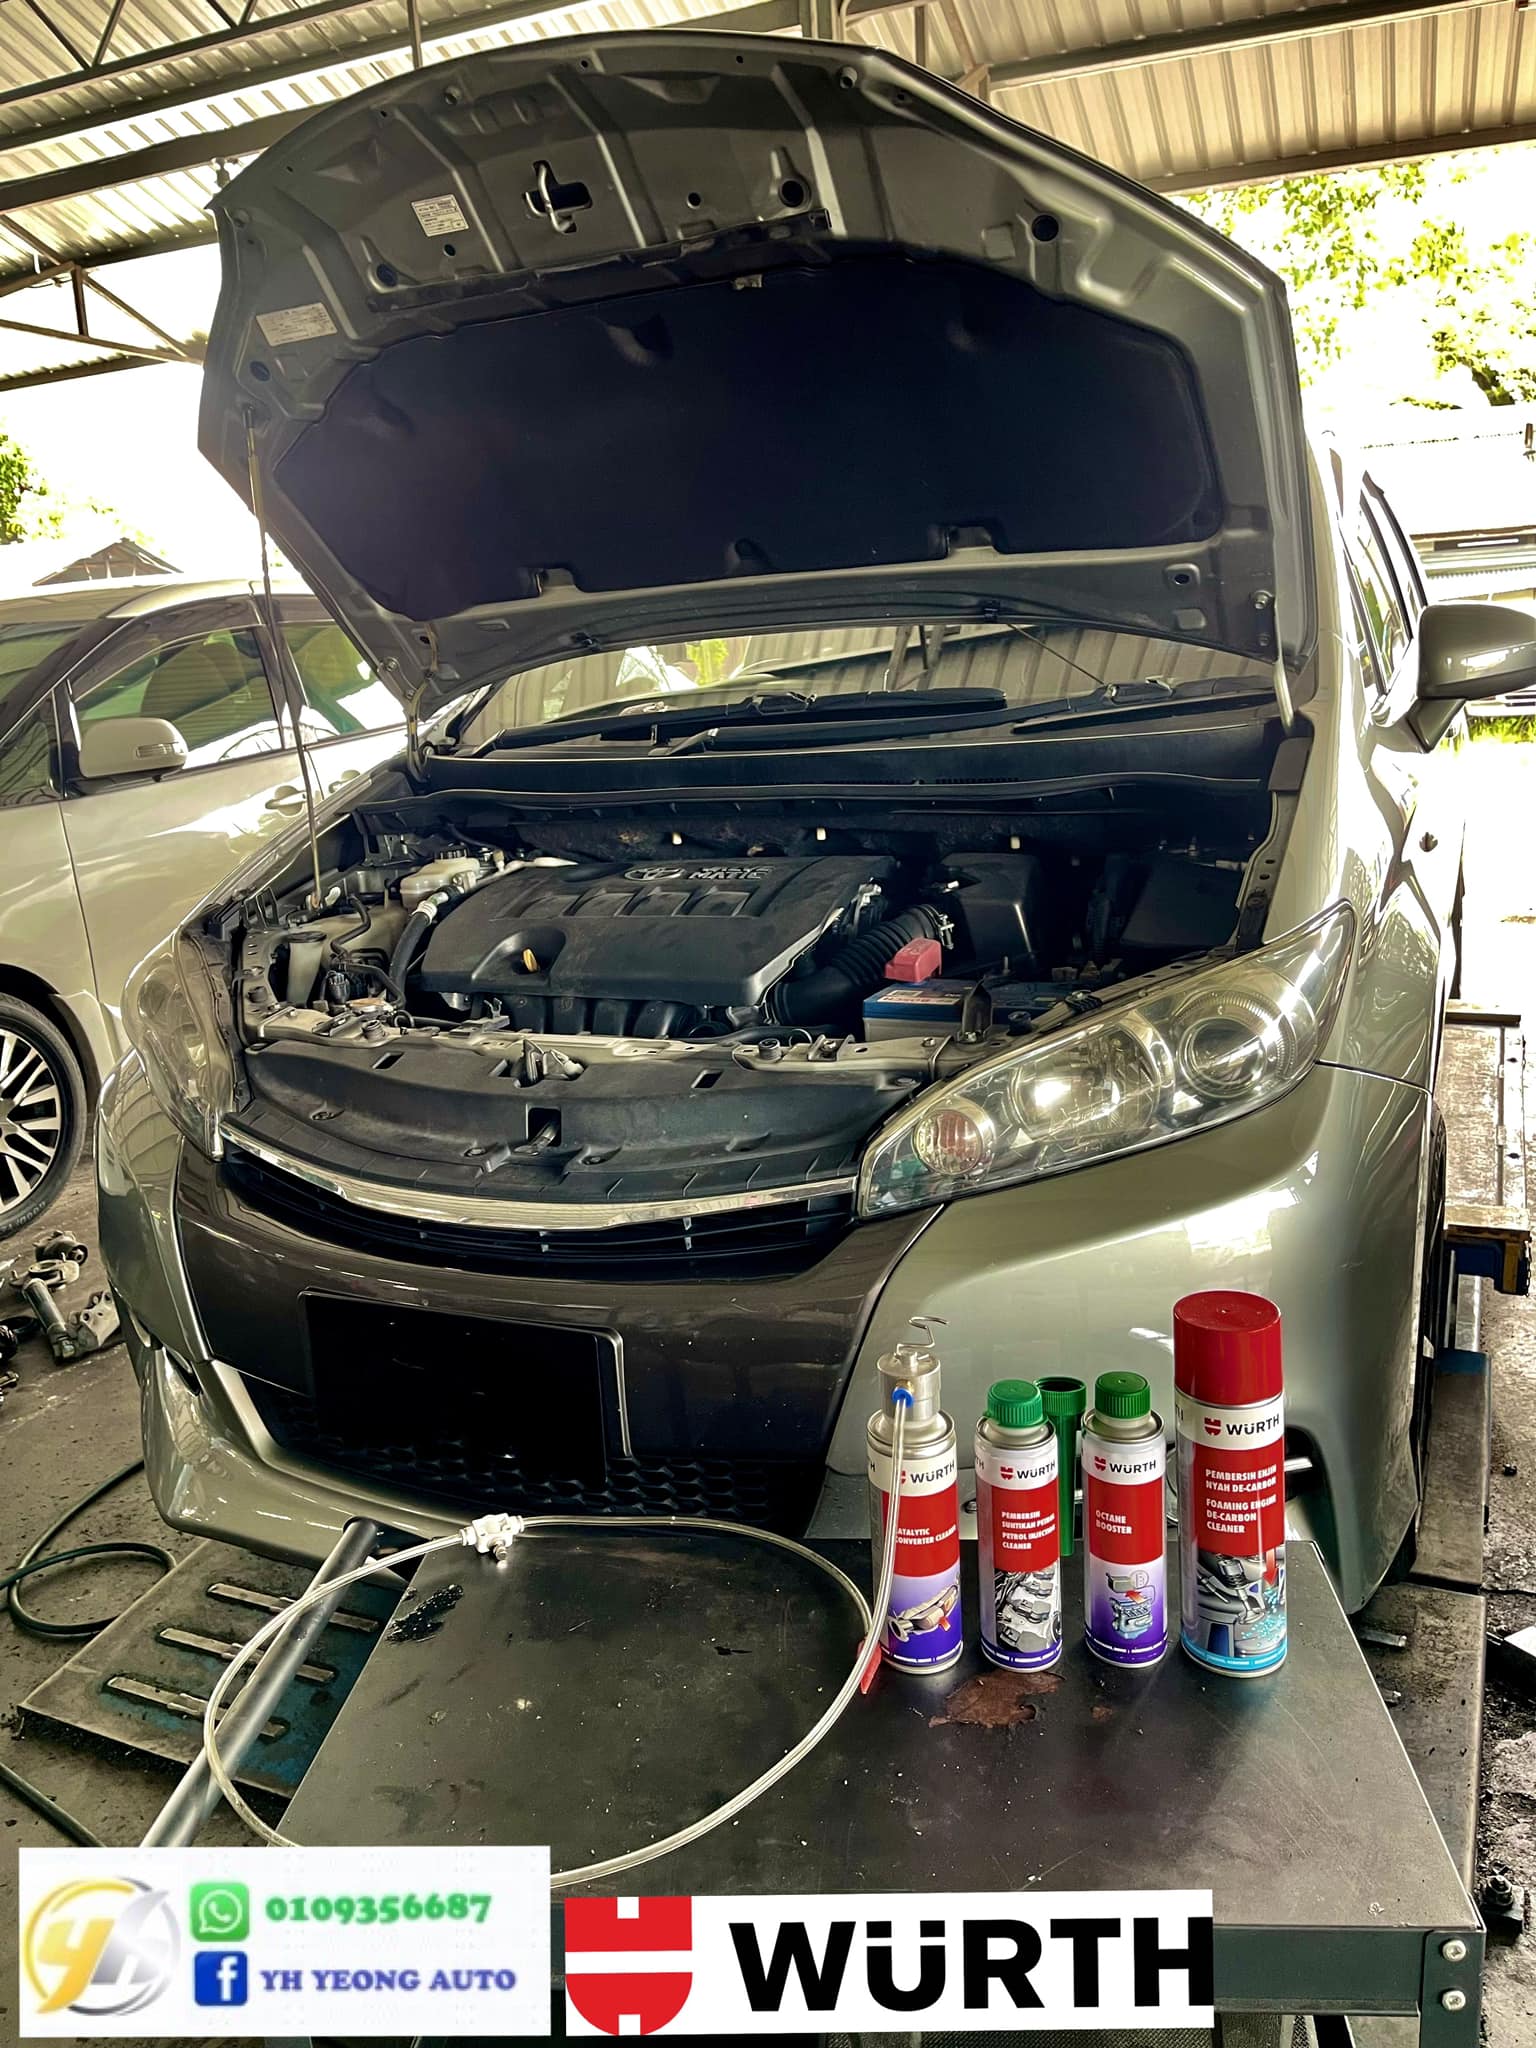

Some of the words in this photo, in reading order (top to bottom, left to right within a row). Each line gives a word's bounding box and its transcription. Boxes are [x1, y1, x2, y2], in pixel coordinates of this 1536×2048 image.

[1226, 1413, 1280, 1435] WÜRTH
[910, 1460, 955, 1484] WÜRTH
[1016, 1460, 1056, 1479] WÜRTH
[1109, 1460, 1156, 1474] WÜRTH
[1231, 1476, 1277, 1493] DE-CARBON
[1206, 1498, 1249, 1510] FOAMING
[1095, 1509, 1127, 1524] OCTANE
[1206, 1509, 1257, 1522] DE-CARBON
[896, 1527, 930, 1536] ATALYTIC
[1095, 1519, 1133, 1535] BOOSTER
[1206, 1520, 1245, 1533] CLEANER
[1002, 1531, 1028, 1541] PETROL
[1002, 1541, 1032, 1550] CLEANER
